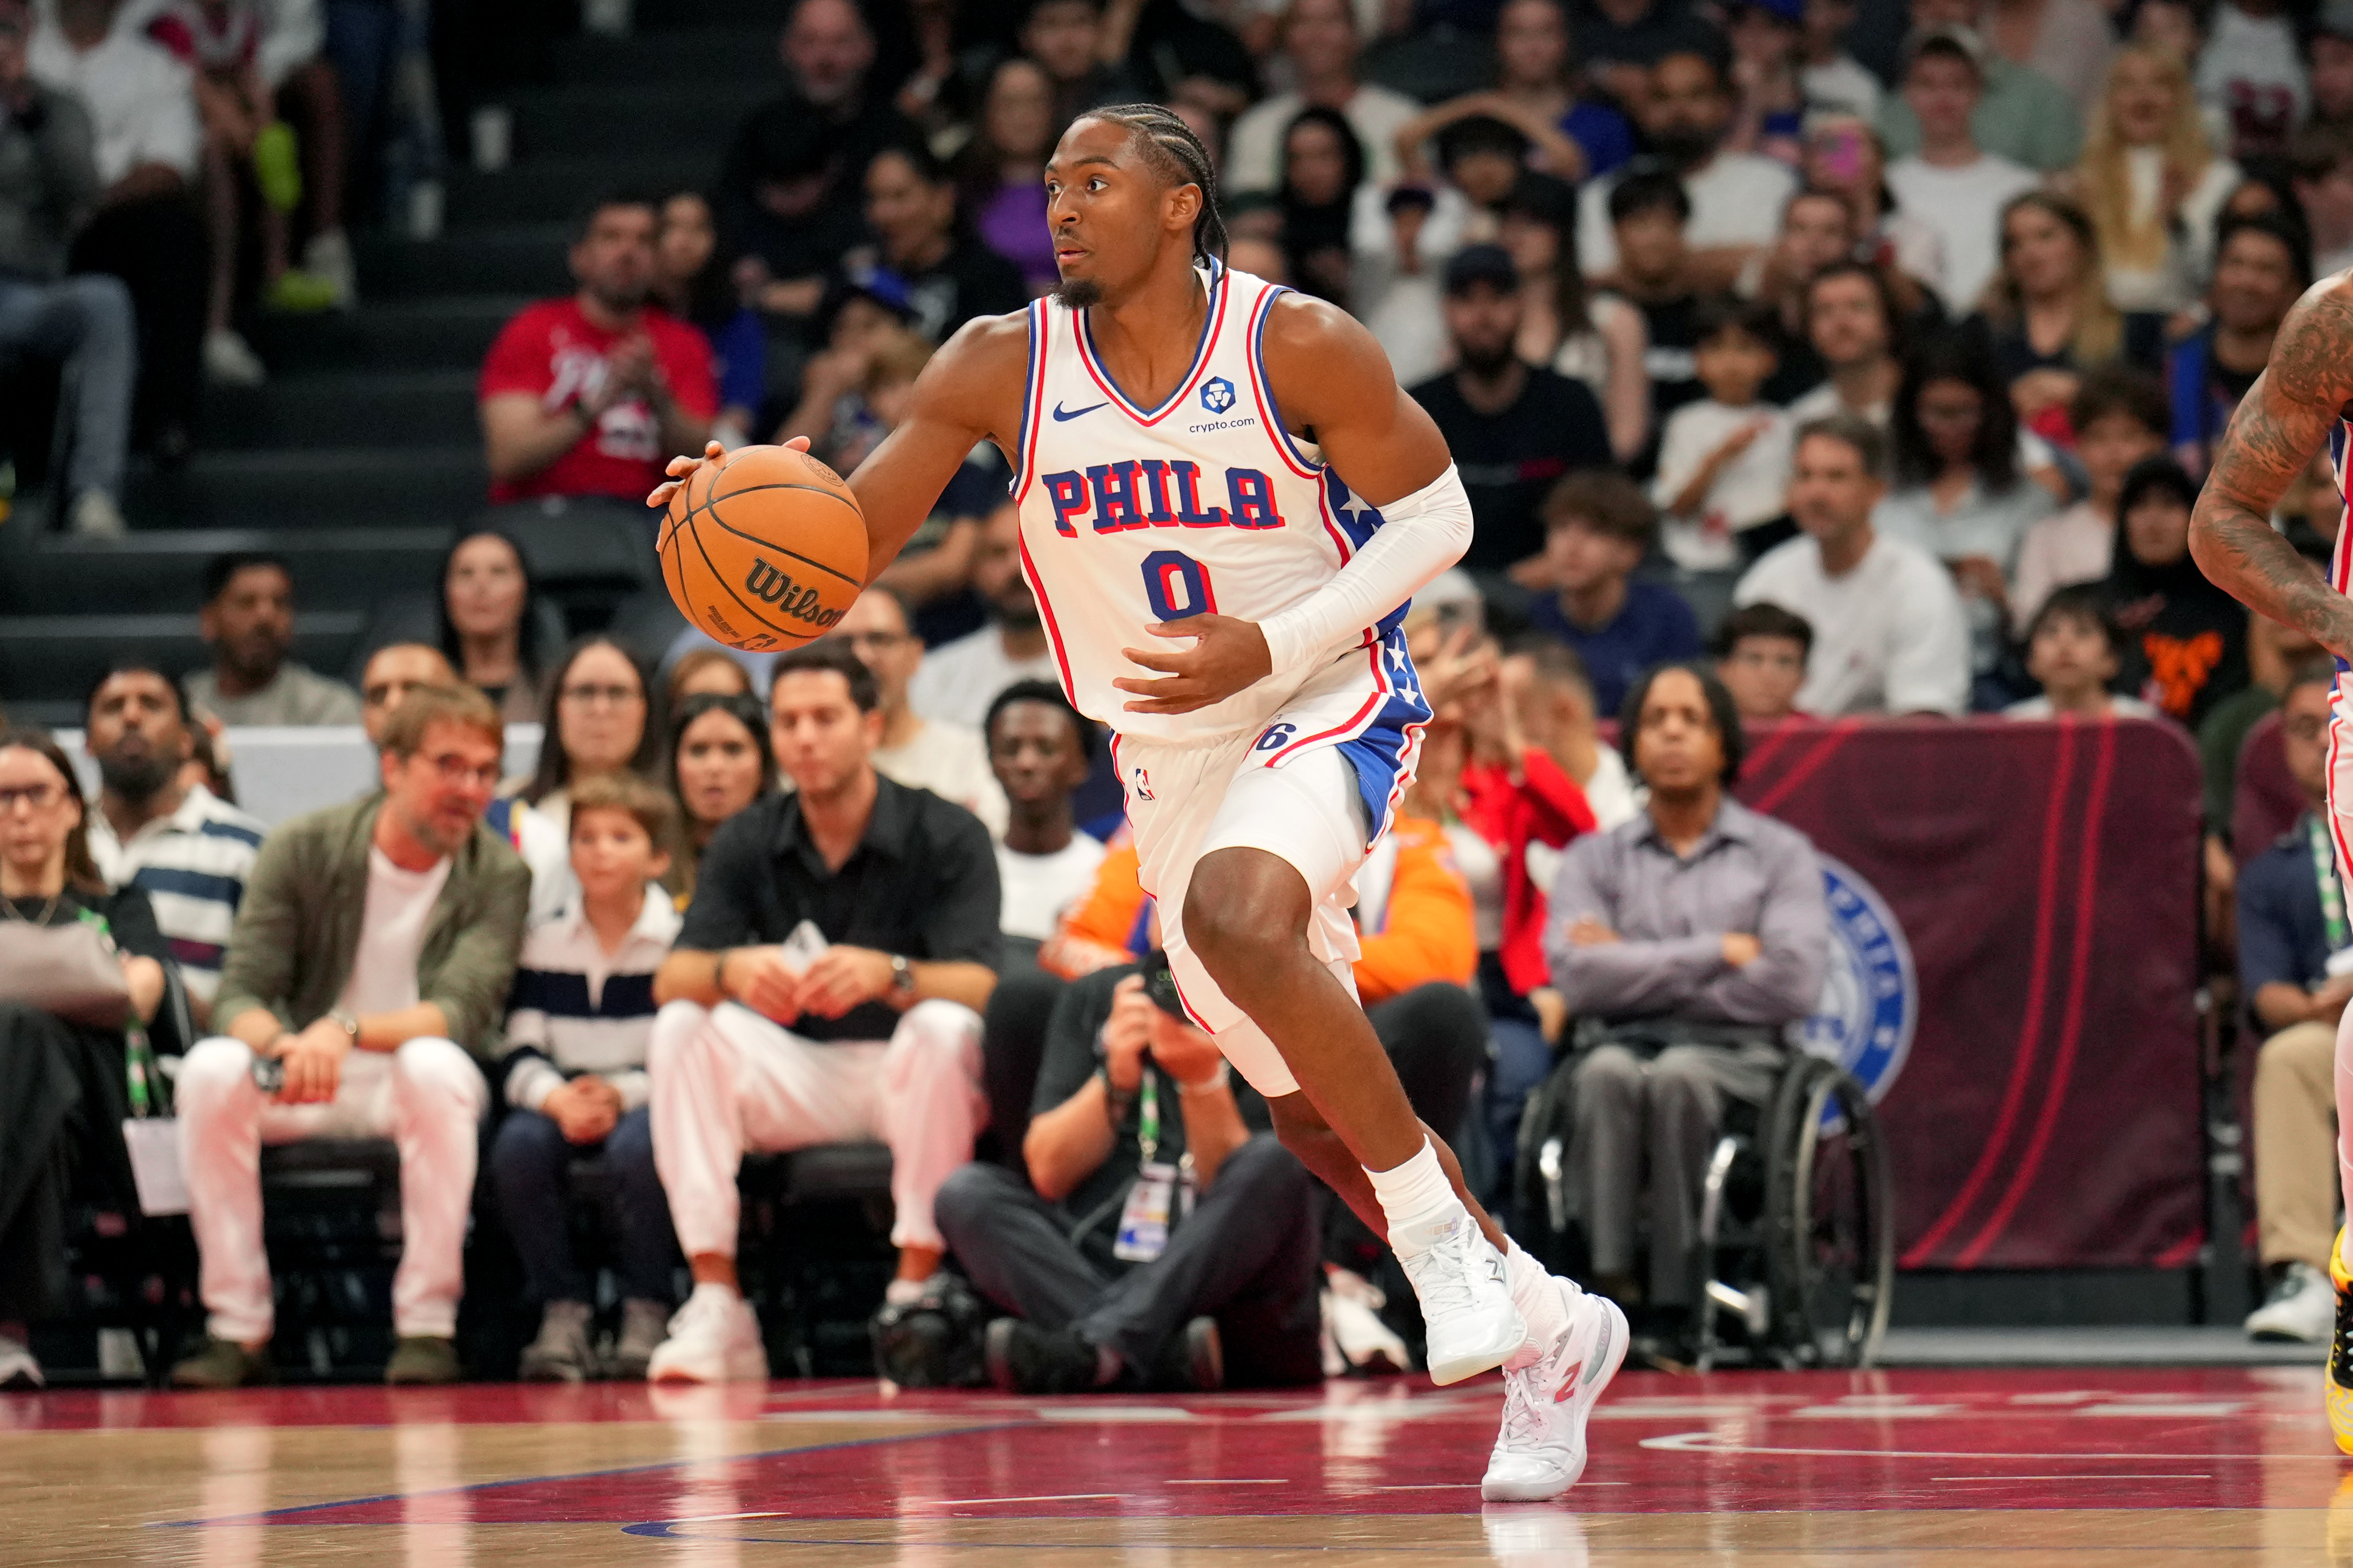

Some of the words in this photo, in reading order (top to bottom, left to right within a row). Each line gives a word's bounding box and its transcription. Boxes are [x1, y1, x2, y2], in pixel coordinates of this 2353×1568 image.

[1189, 418, 1254, 433] crypto.com
[1041, 459, 1285, 538] PHILA
[745, 555, 847, 628] Wilson
[1141, 550, 1218, 623] 0
